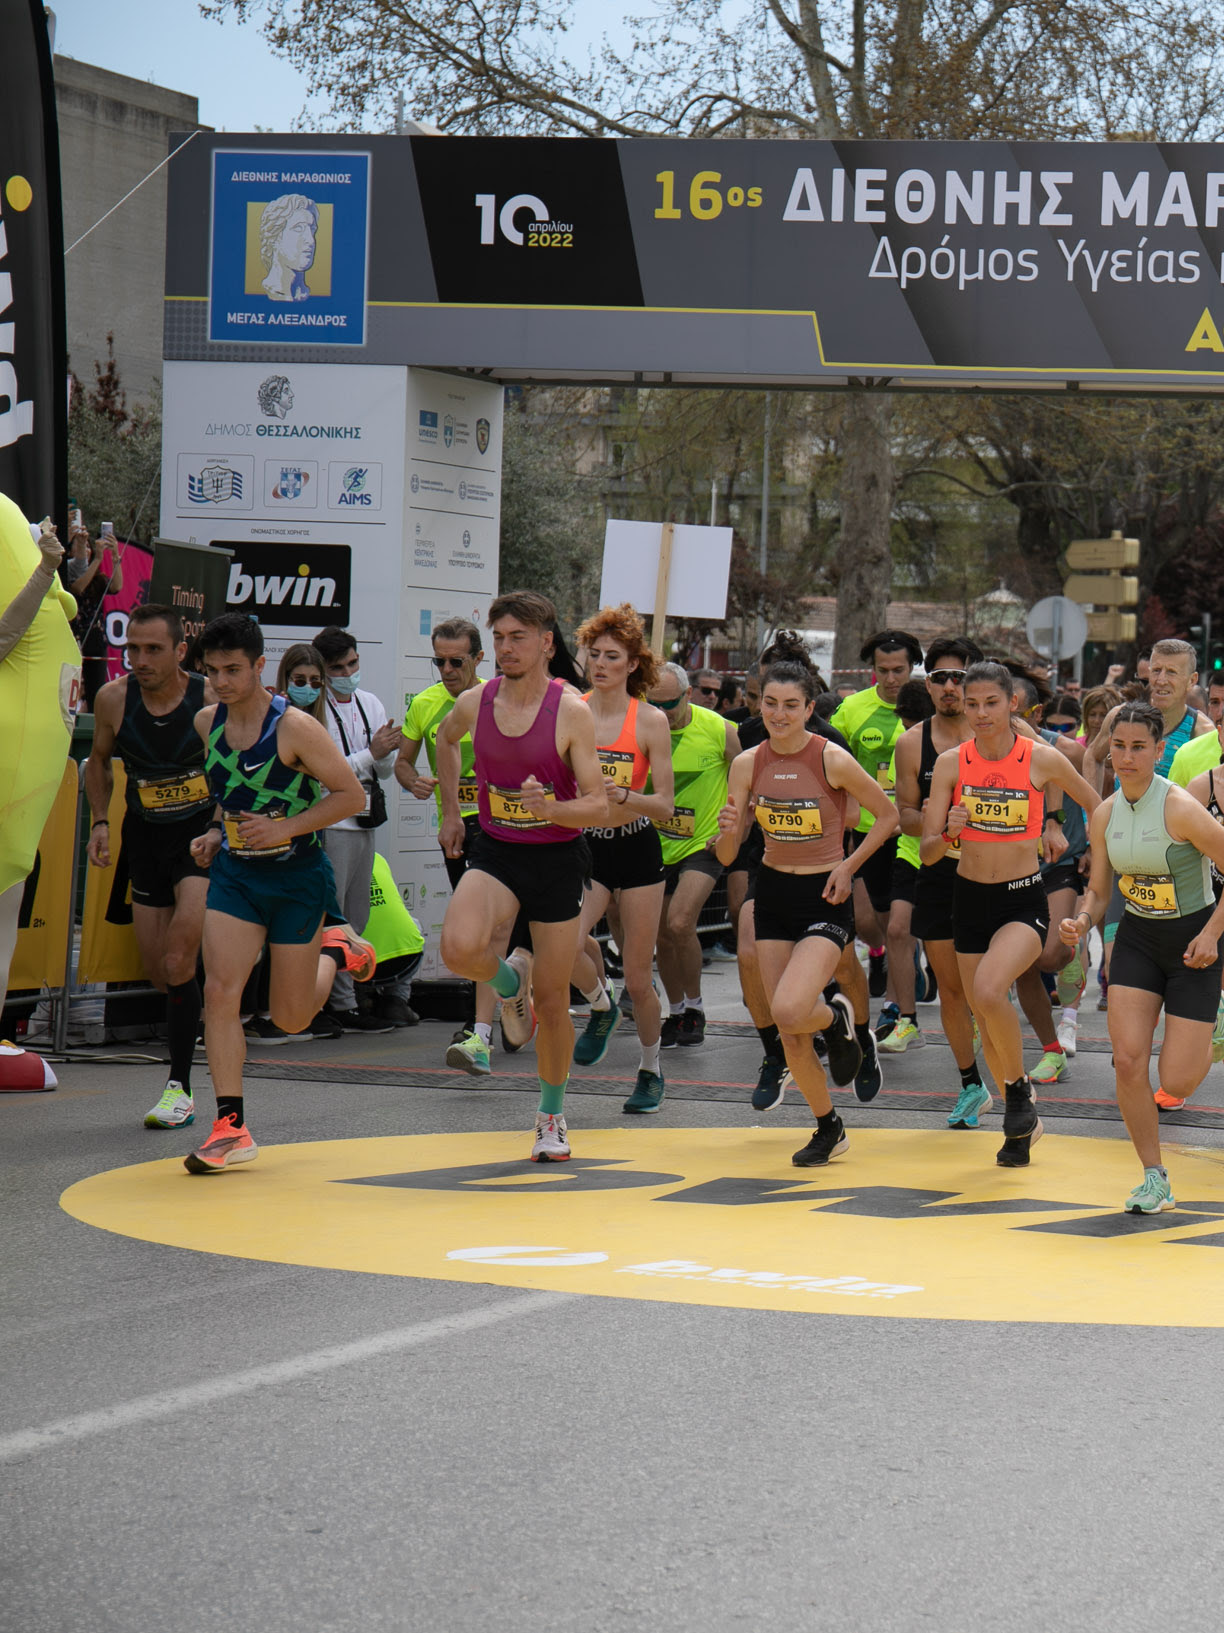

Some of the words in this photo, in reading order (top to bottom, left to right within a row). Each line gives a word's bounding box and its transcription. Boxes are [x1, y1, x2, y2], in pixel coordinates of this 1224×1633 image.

[231, 171, 279, 182] ΔΙΕΘΝΗΣ
[281, 173, 352, 184] ΜΑΡΑΘΩΝΙΟΣ
[782, 168, 1074, 226] ΔΙΕΘΝΗΣ
[475, 193, 550, 246] 10
[528, 233, 574, 248] 2022
[868, 234, 1039, 290] Δρόμος
[1057, 237, 1201, 292] Υγείας
[227, 312, 265, 324] ΜΕΓΑΣ
[268, 314, 347, 327] ΑΛΕΞΑΝΔΡΟΣ
[205, 423, 252, 437] ΔΗΜΟΣ
[256, 424, 362, 440] ΘΕΣΣΑΛΟΝΙΚΗΣ
[338, 493, 372, 505] AIMS
[226, 563, 337, 607] bwin
[172, 585, 204, 614] Timing
[862, 734, 882, 742] bwin
[155, 785, 191, 799] 5279
[975, 803, 1010, 817] 8791
[768, 814, 803, 826] 8790
[1008, 877, 1031, 890] NIKE
